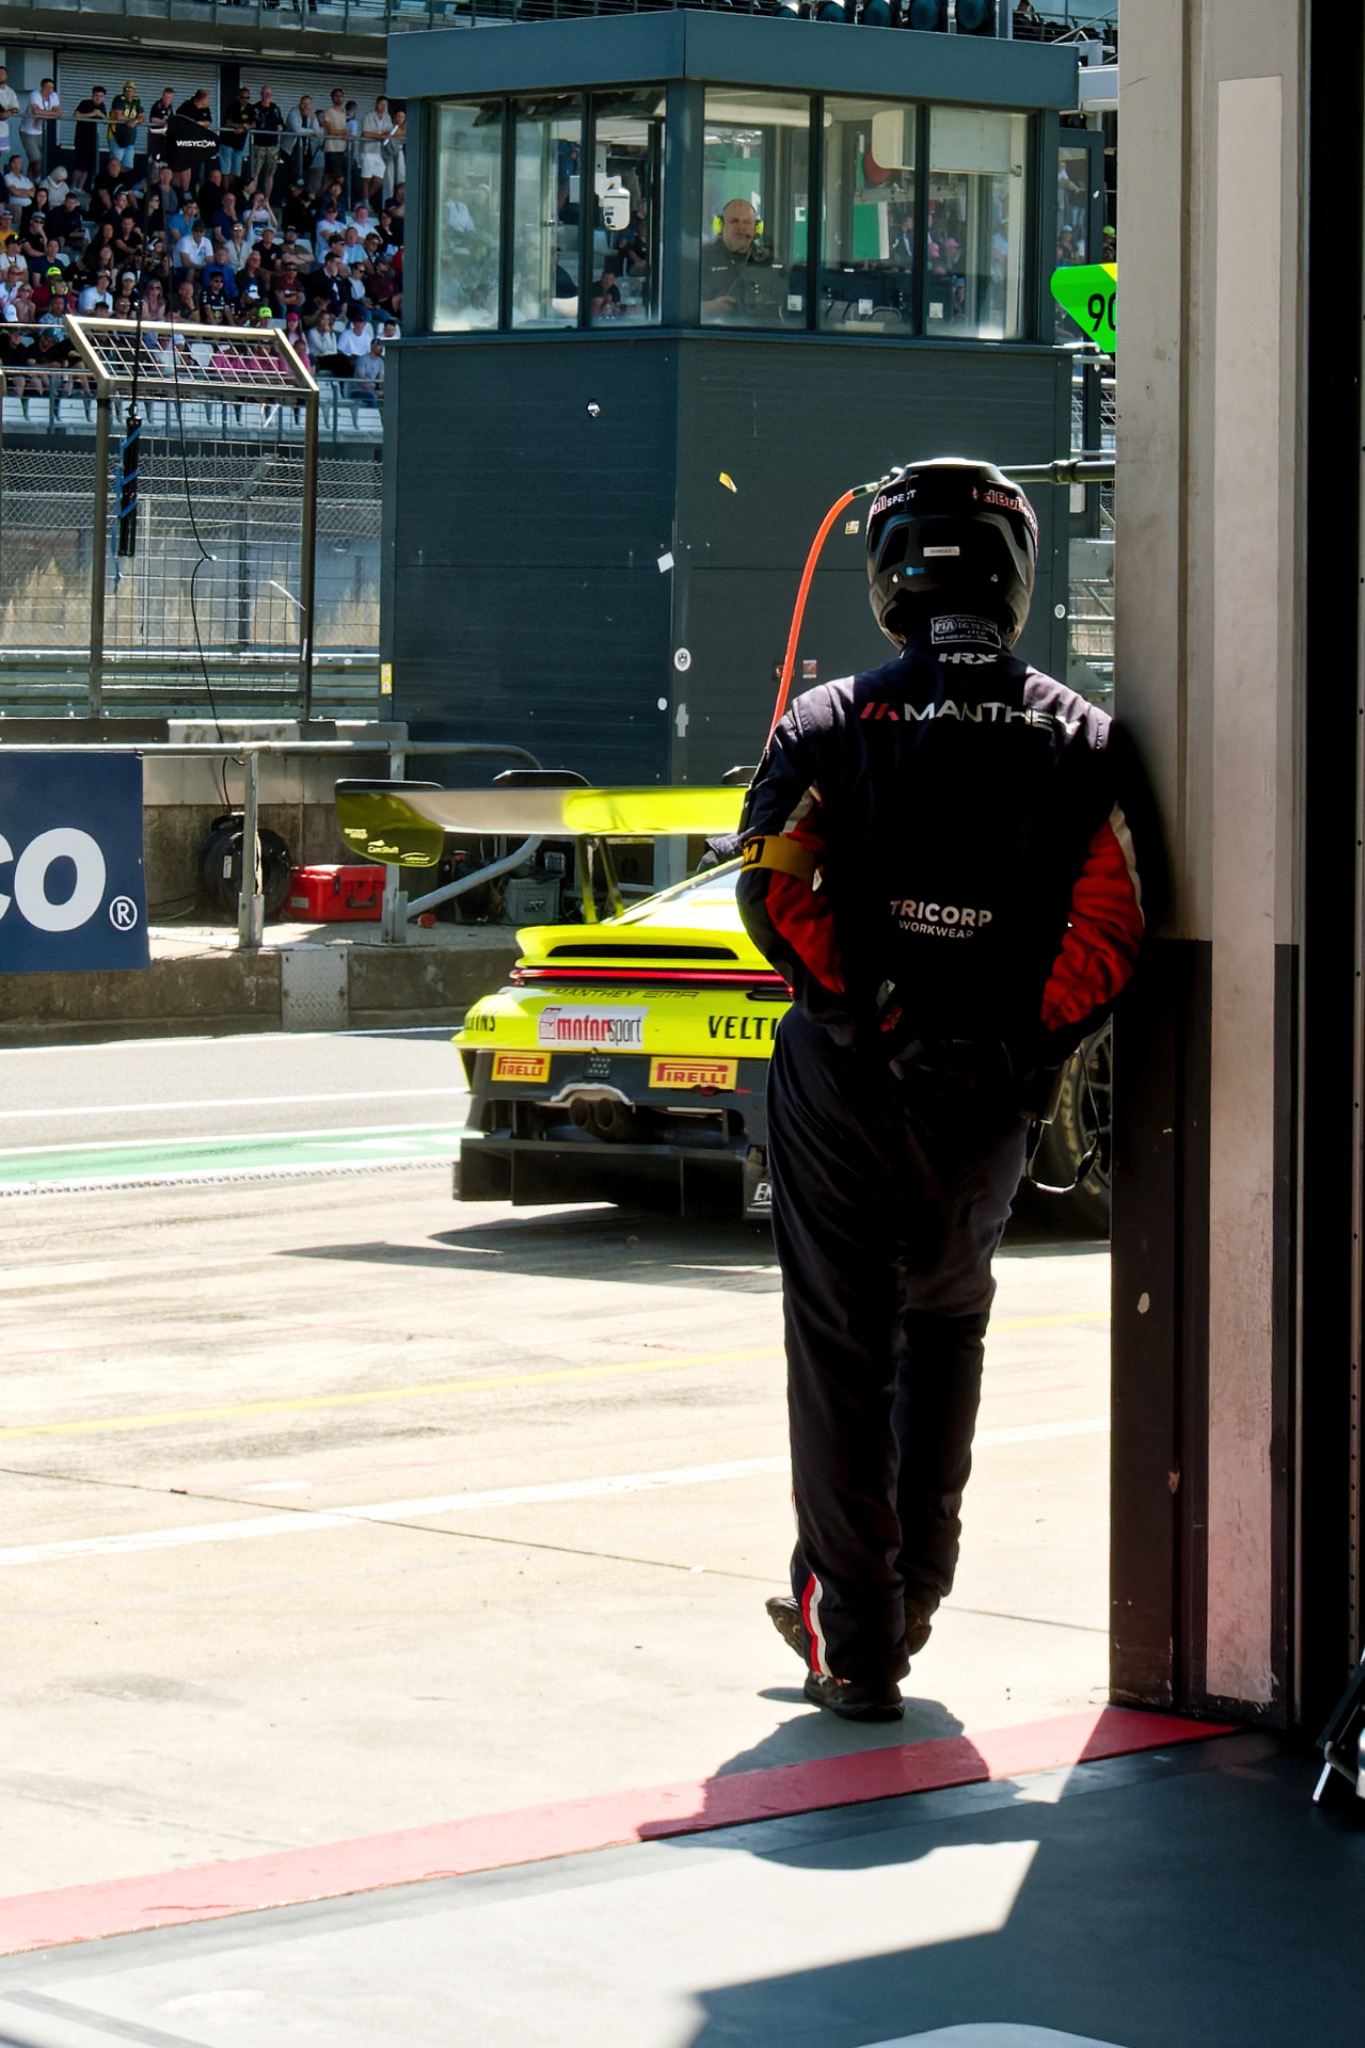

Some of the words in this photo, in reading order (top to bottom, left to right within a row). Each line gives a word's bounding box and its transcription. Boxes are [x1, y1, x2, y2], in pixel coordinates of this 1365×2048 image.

[176, 140, 216, 148] WISYCOM
[938, 652, 998, 664] HRX
[890, 899, 993, 928] TRICORP
[899, 920, 974, 939] WORKWEAR
[557, 1015, 642, 1045] motorsport
[496, 1057, 545, 1076] PIRELLI
[656, 1062, 729, 1084] PIRELLI
